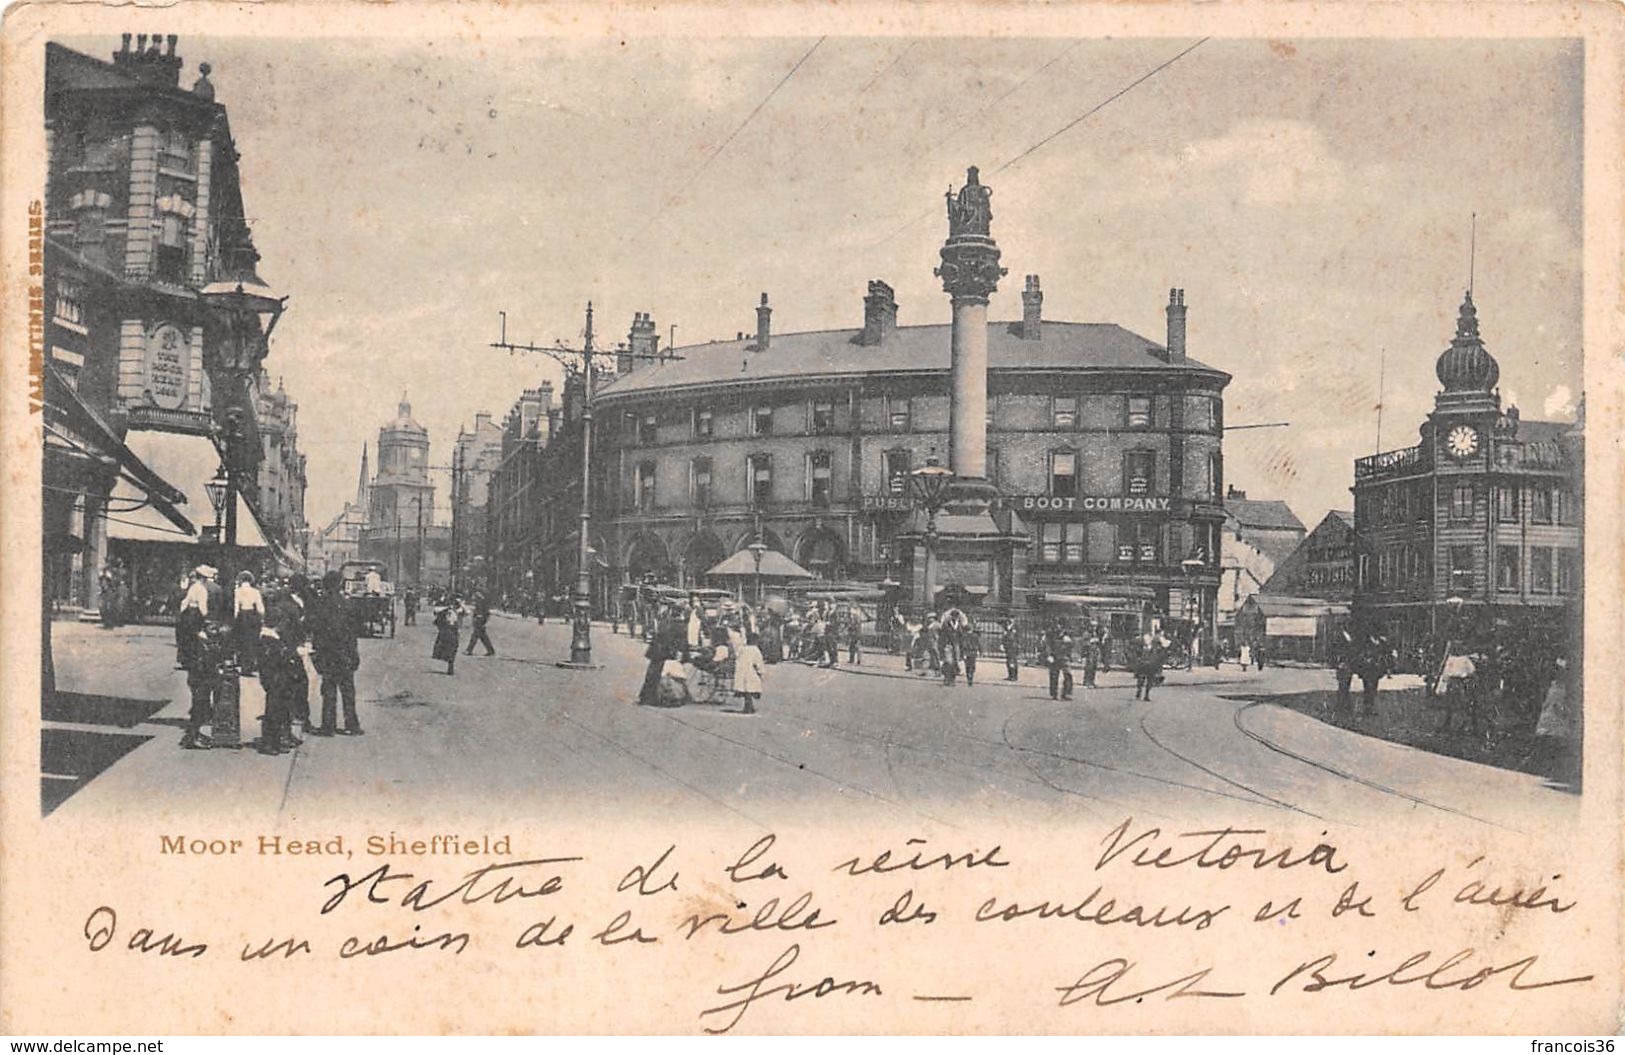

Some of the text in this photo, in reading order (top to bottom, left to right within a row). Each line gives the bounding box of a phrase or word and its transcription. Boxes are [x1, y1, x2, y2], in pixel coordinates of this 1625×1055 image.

[28, 199, 43, 276] SERIES
[863, 497, 924, 510] PUBLI
[1024, 497, 1076, 509] BOOT
[160, 831, 512, 858] Moor Head, Sheffield
[617, 845, 680, 896] de
[726, 834, 789, 882] la
[515, 914, 575, 948] de
[592, 908, 657, 946] la
